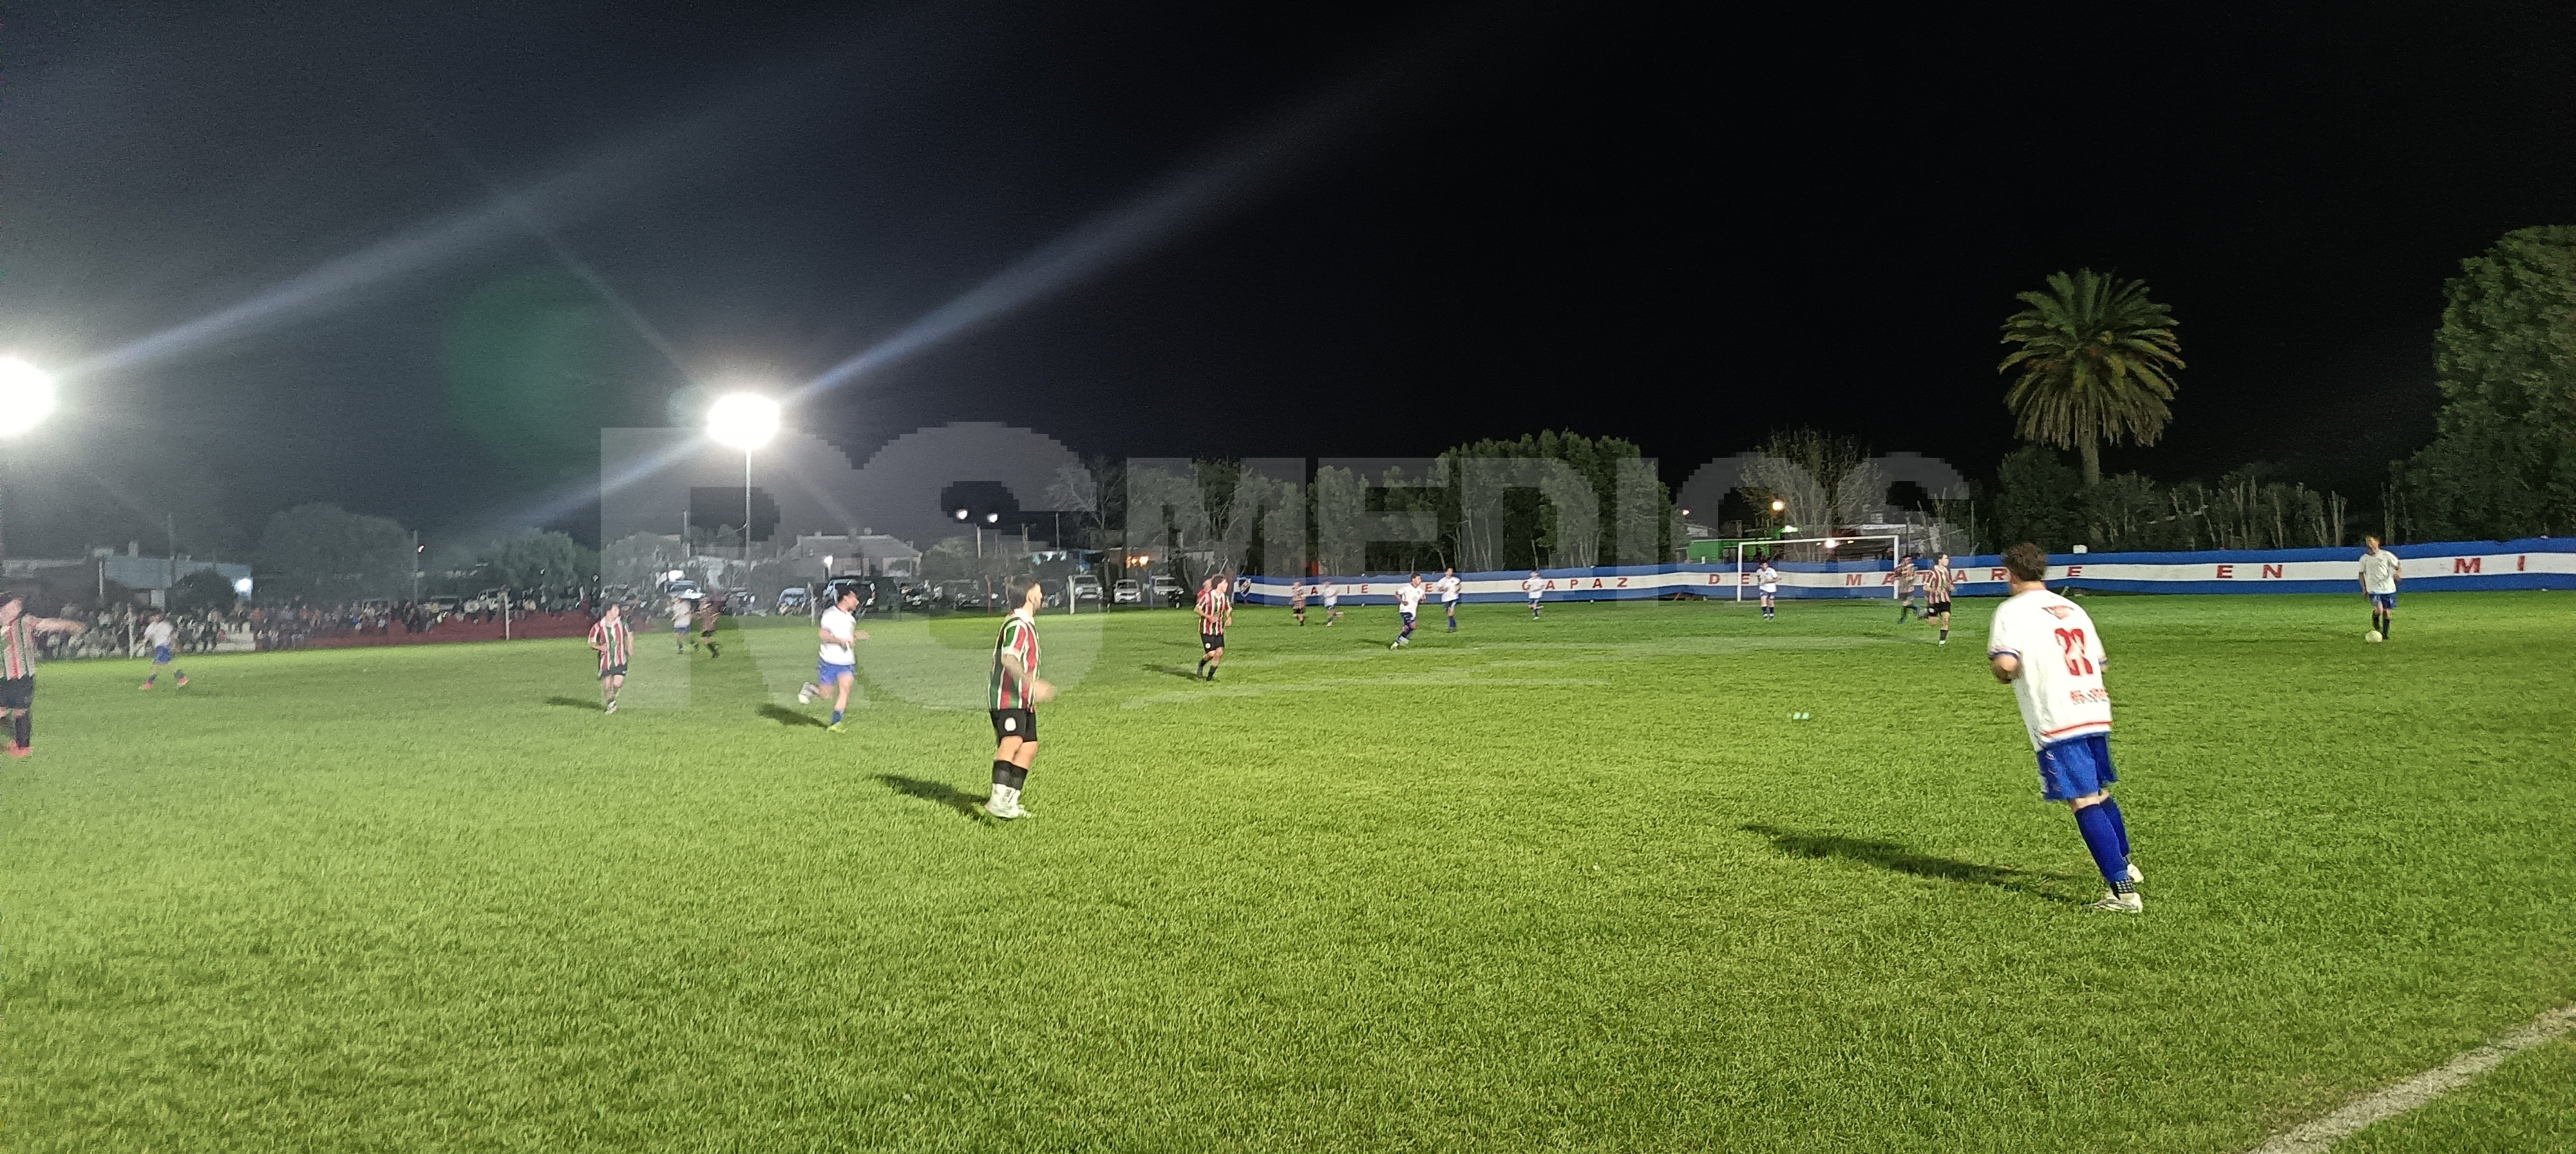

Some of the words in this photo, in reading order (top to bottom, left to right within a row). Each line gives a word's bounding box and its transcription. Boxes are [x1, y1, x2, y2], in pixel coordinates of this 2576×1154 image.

[1709, 573, 1751, 585] DE
[1846, 566, 2083, 586] MATARE
[2217, 564, 2283, 579] EN
[2454, 555, 2526, 574] MI
